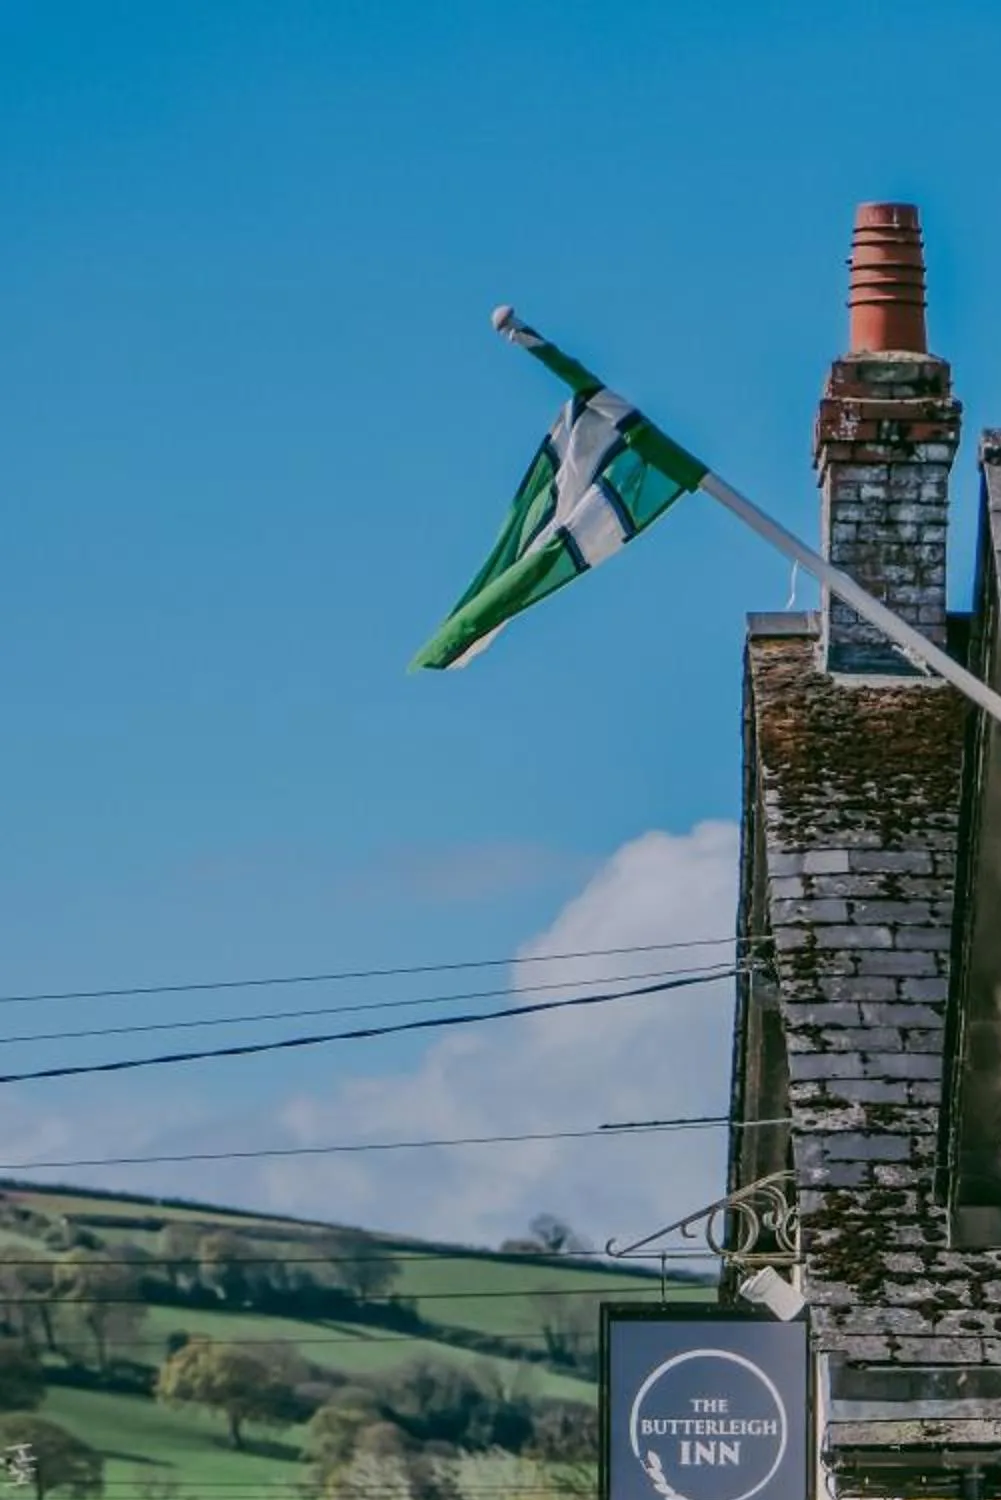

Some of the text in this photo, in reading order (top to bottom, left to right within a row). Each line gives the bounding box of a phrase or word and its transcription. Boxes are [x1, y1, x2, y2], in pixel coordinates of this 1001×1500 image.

[690, 1398, 729, 1413] THE
[641, 1419, 777, 1435] BUTTERLEIGH
[680, 1440, 741, 1465] INN
